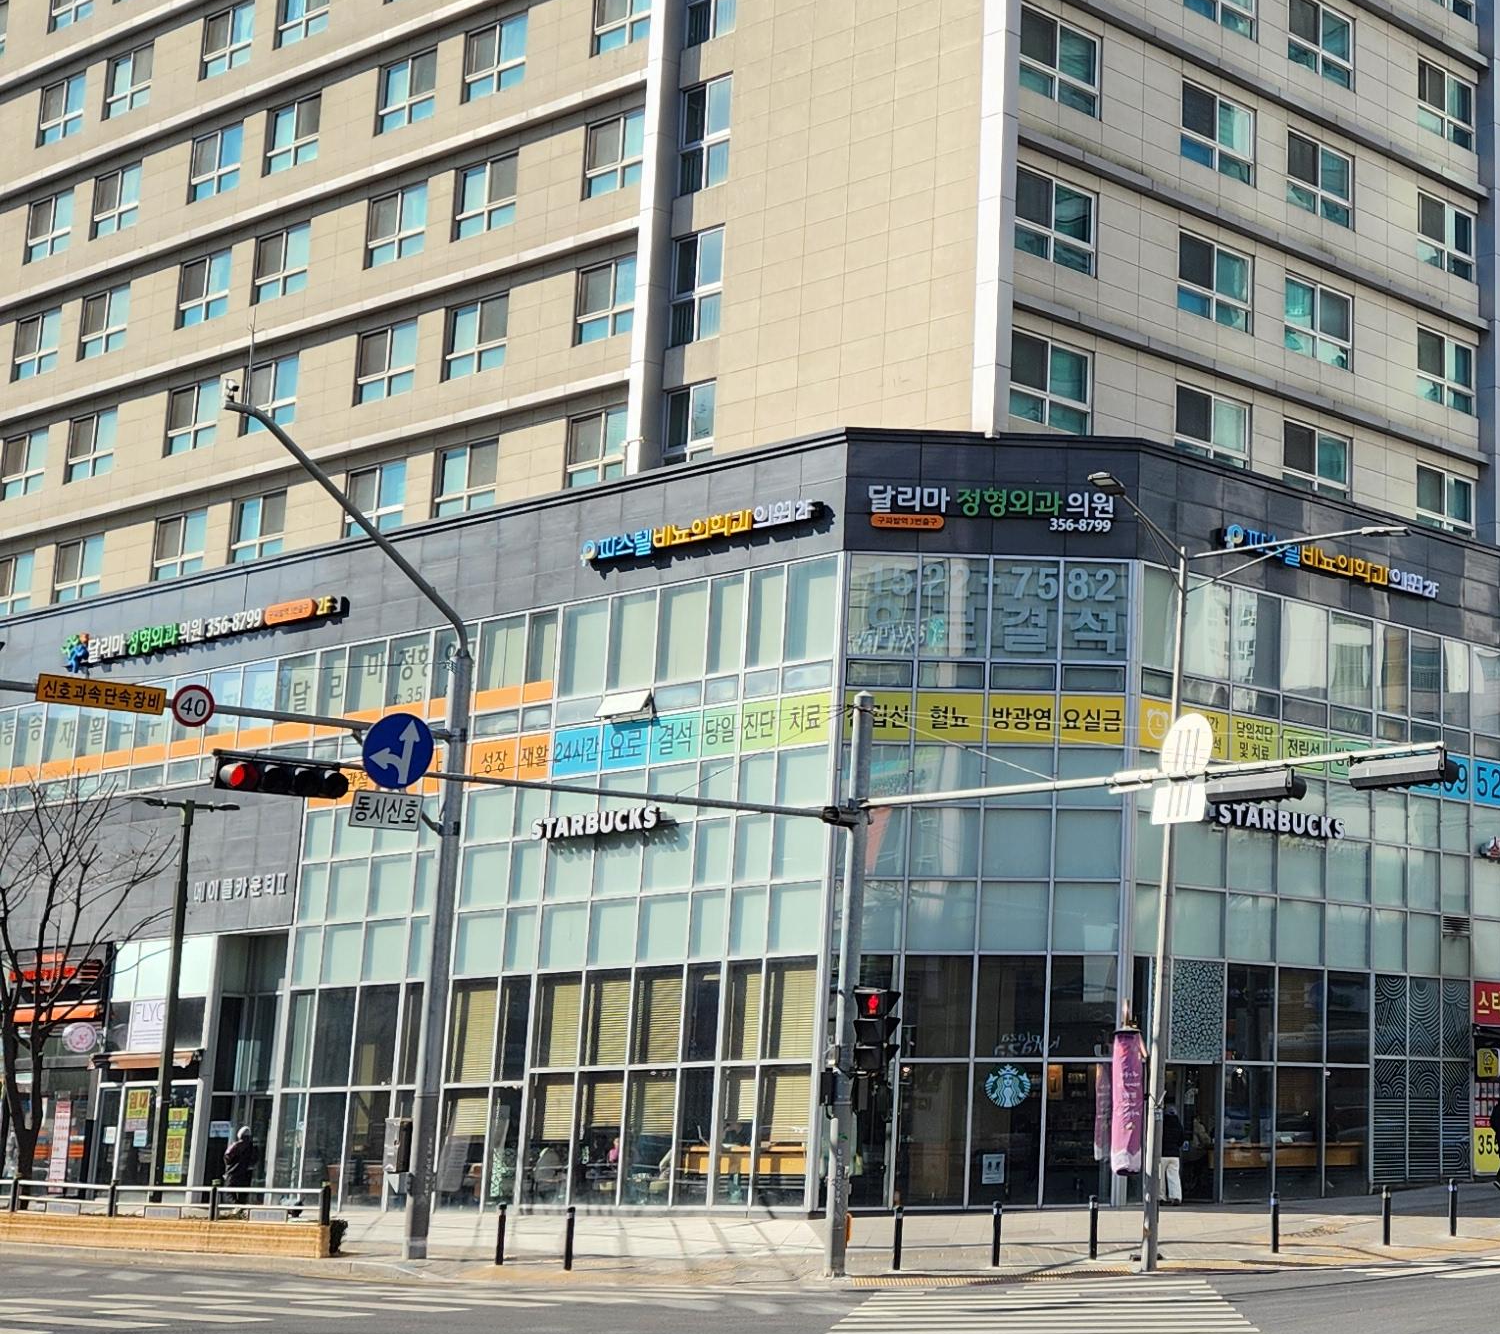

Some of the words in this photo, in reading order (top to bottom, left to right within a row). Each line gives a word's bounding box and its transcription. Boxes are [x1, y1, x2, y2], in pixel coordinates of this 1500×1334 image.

[868, 484, 950, 513] 달리마
[956, 487, 1062, 517] 정형외과
[1065, 490, 1115, 518] 의원
[1049, 517, 1112, 533] 356-8799
[205, 608, 263, 637] 356-8799
[42, 680, 161, 710] 신호과속단속장비
[180, 696, 207, 717] 40
[847, 703, 909, 729] 립선
[929, 705, 970, 730] 혈뇨
[991, 706, 1053, 731] 방광염
[1060, 708, 1122, 732] 요실금
[1236, 720, 1274, 743] 당일진단
[480, 749, 509, 773] 성장
[521, 745, 550, 769] 재활
[555, 733, 600, 763] 24시간
[609, 730, 643, 760] 요로
[657, 719, 694, 755] 결석
[705, 714, 736, 745] 당일
[743, 709, 776, 740] 진단
[789, 704, 821, 732] 치료
[354, 795, 420, 824] 동시신호
[530, 805, 658, 841] STARBUCKS
[1218, 802, 1346, 840] STARBUCKS
